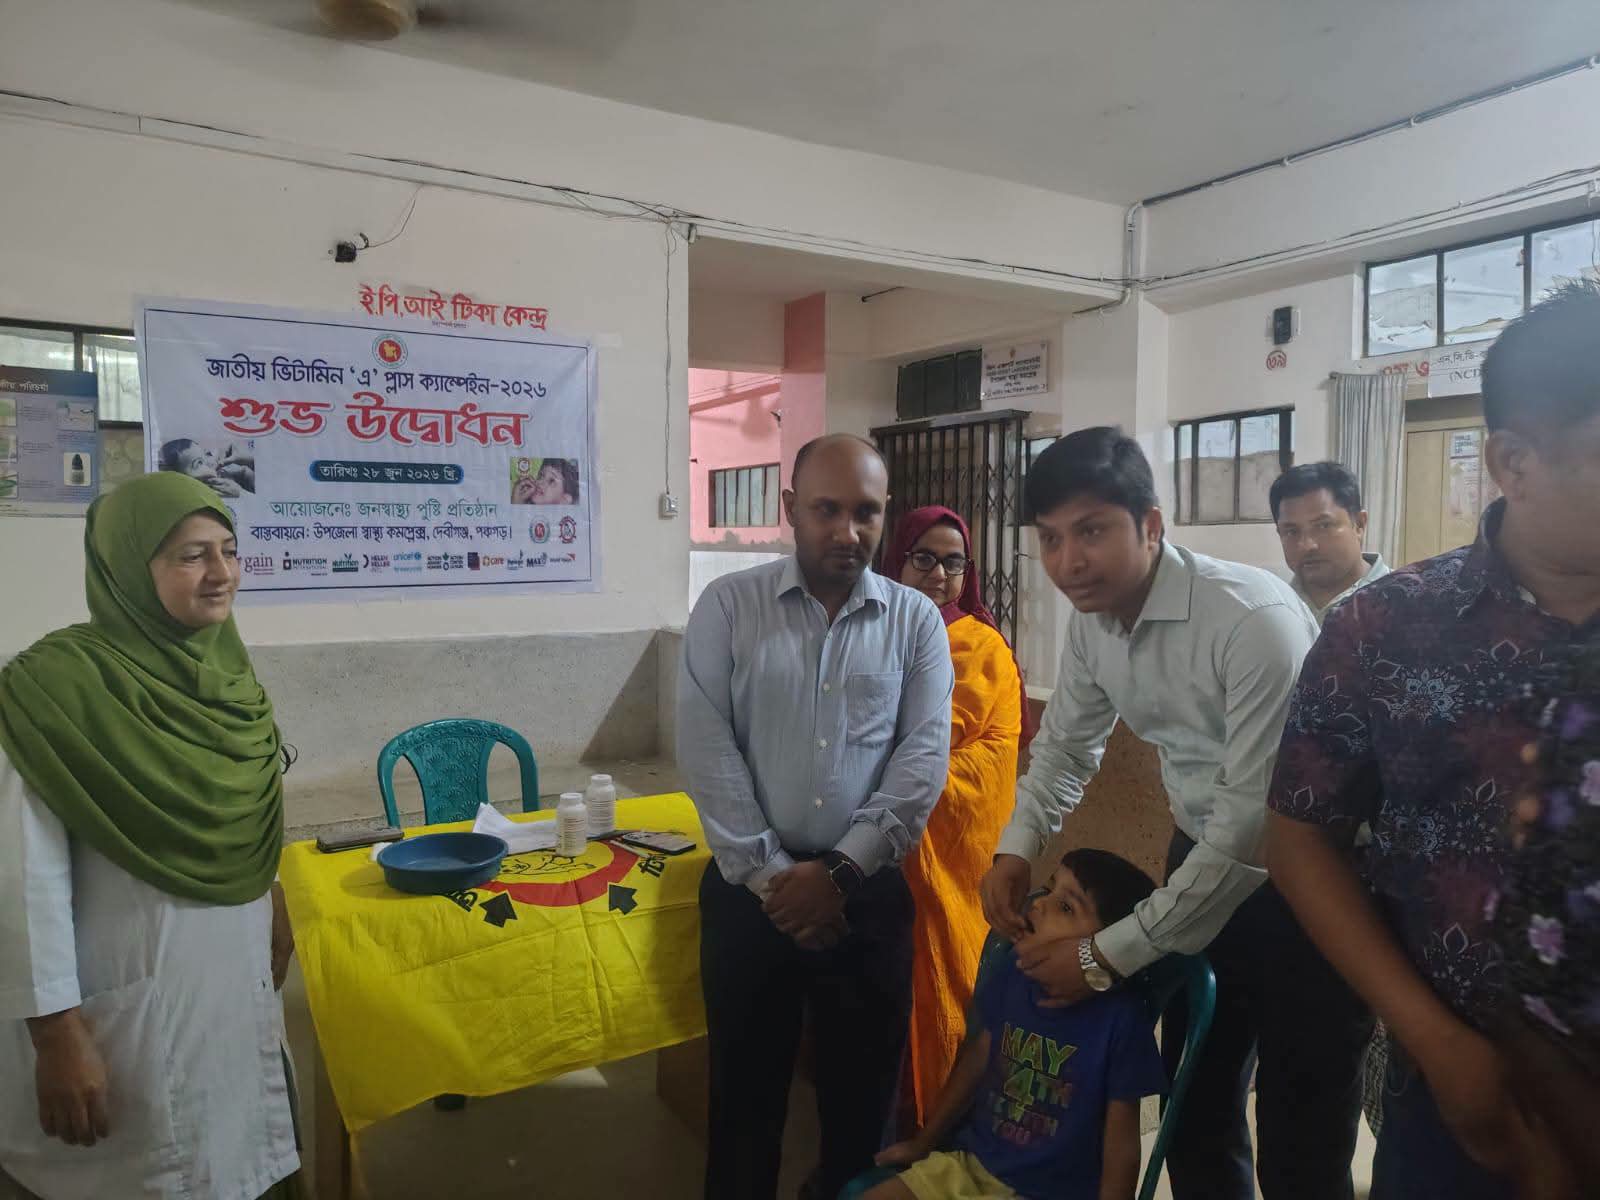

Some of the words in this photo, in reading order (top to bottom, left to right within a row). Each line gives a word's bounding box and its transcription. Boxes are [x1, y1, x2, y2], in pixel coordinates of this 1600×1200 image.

[450, 292, 500, 326] টিকা
[503, 304, 549, 332] কেন্দ্র
[205, 353, 266, 382] জাতীয়
[271, 355, 344, 385] ভিটামিন
[384, 371, 415, 395] প্লাস
[419, 372, 547, 398] ক্যাম্পেইন-২০২৬
[220, 397, 331, 434] শুভ
[345, 391, 529, 446] উদ্বোধন
[320, 462, 358, 478] তারিখঃ
[362, 466, 380, 479] ২৮
[384, 466, 402, 480] জুন
[407, 468, 439, 481] ২০২৬
[270, 502, 351, 517] আয়োজনেঃ
[356, 502, 411, 520] জনস্বাস্থ্য
[417, 498, 442, 521] পুষ্টি
[447, 498, 498, 518] প্রতিষ্ঠান
[313, 522, 358, 540] উপজেলা
[361, 526, 384, 543] স্বাস্থ্য
[244, 552, 273, 573] gain
[1002, 1022, 1079, 1077] MAY
